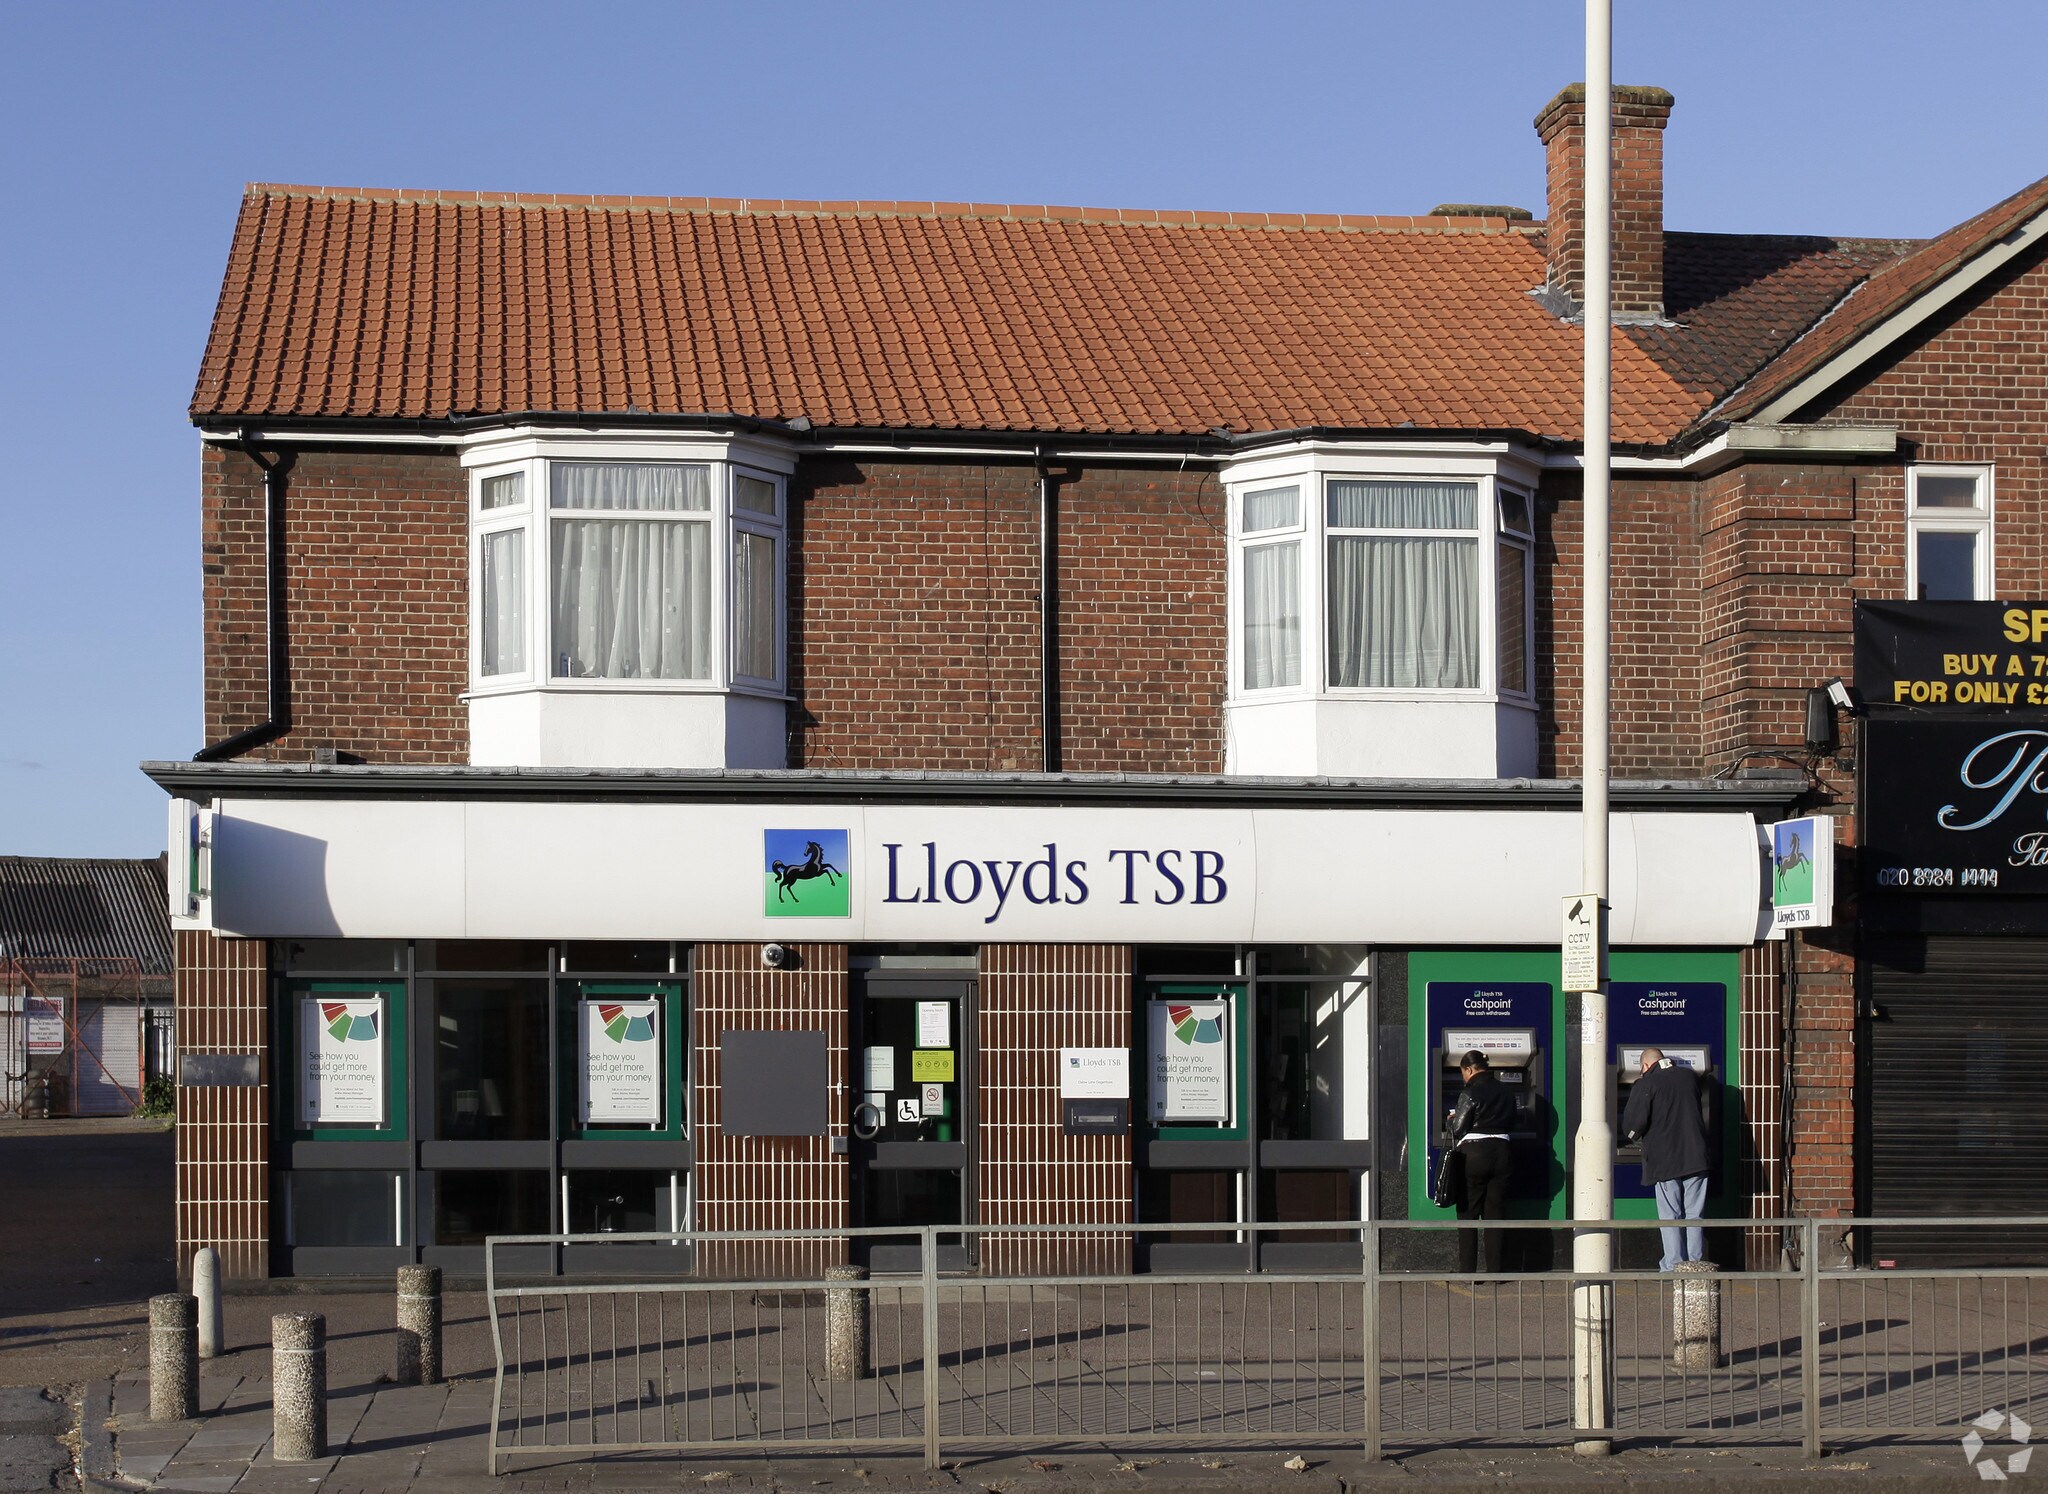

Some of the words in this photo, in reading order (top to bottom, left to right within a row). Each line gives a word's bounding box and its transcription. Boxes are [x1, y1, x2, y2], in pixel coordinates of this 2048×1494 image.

[1943, 654, 1998, 676] BUY
[2006, 655, 2025, 677] A
[2030, 655, 2048, 677] 7
[1894, 681, 1947, 702] FOR
[1954, 681, 2020, 704] ONLY
[882, 841, 1089, 924] Lloyds
[1108, 849, 1228, 905] TSB
[1777, 910, 1796, 926] Lloyds
[1797, 909, 1810, 921] TSB
[1568, 933, 1590, 943] CCTV
[1463, 998, 1512, 1010] Cashpoint
[1638, 998, 1686, 1010] Cashpoint
[309, 1052, 324, 1061] See
[325, 1051, 343, 1061] how
[345, 1053, 359, 1062] you
[586, 1052, 601, 1061] See
[603, 1052, 621, 1061] how
[621, 1054, 636, 1063] you
[1156, 1053, 1171, 1063] See
[1172, 1053, 1189, 1063] how
[1190, 1055, 1205, 1064] you
[309, 1062, 331, 1071] could
[332, 1062, 345, 1073] get
[347, 1063, 368, 1071] more
[586, 1062, 608, 1072] could
[610, 1063, 622, 1074] get
[623, 1064, 645, 1072] more
[1083, 1058, 1106, 1068] Lloyds
[1107, 1058, 1121, 1066] TSB
[1156, 1064, 1178, 1073] could
[1179, 1065, 1192, 1075] get
[309, 1073, 328, 1081] from
[329, 1074, 347, 1083] your
[586, 1073, 605, 1082] from
[606, 1074, 624, 1083] your
[625, 1074, 653, 1083] money.
[1156, 1074, 1175, 1083] from
[1176, 1075, 1193, 1085] your
[1194, 1075, 1220, 1084] money.
